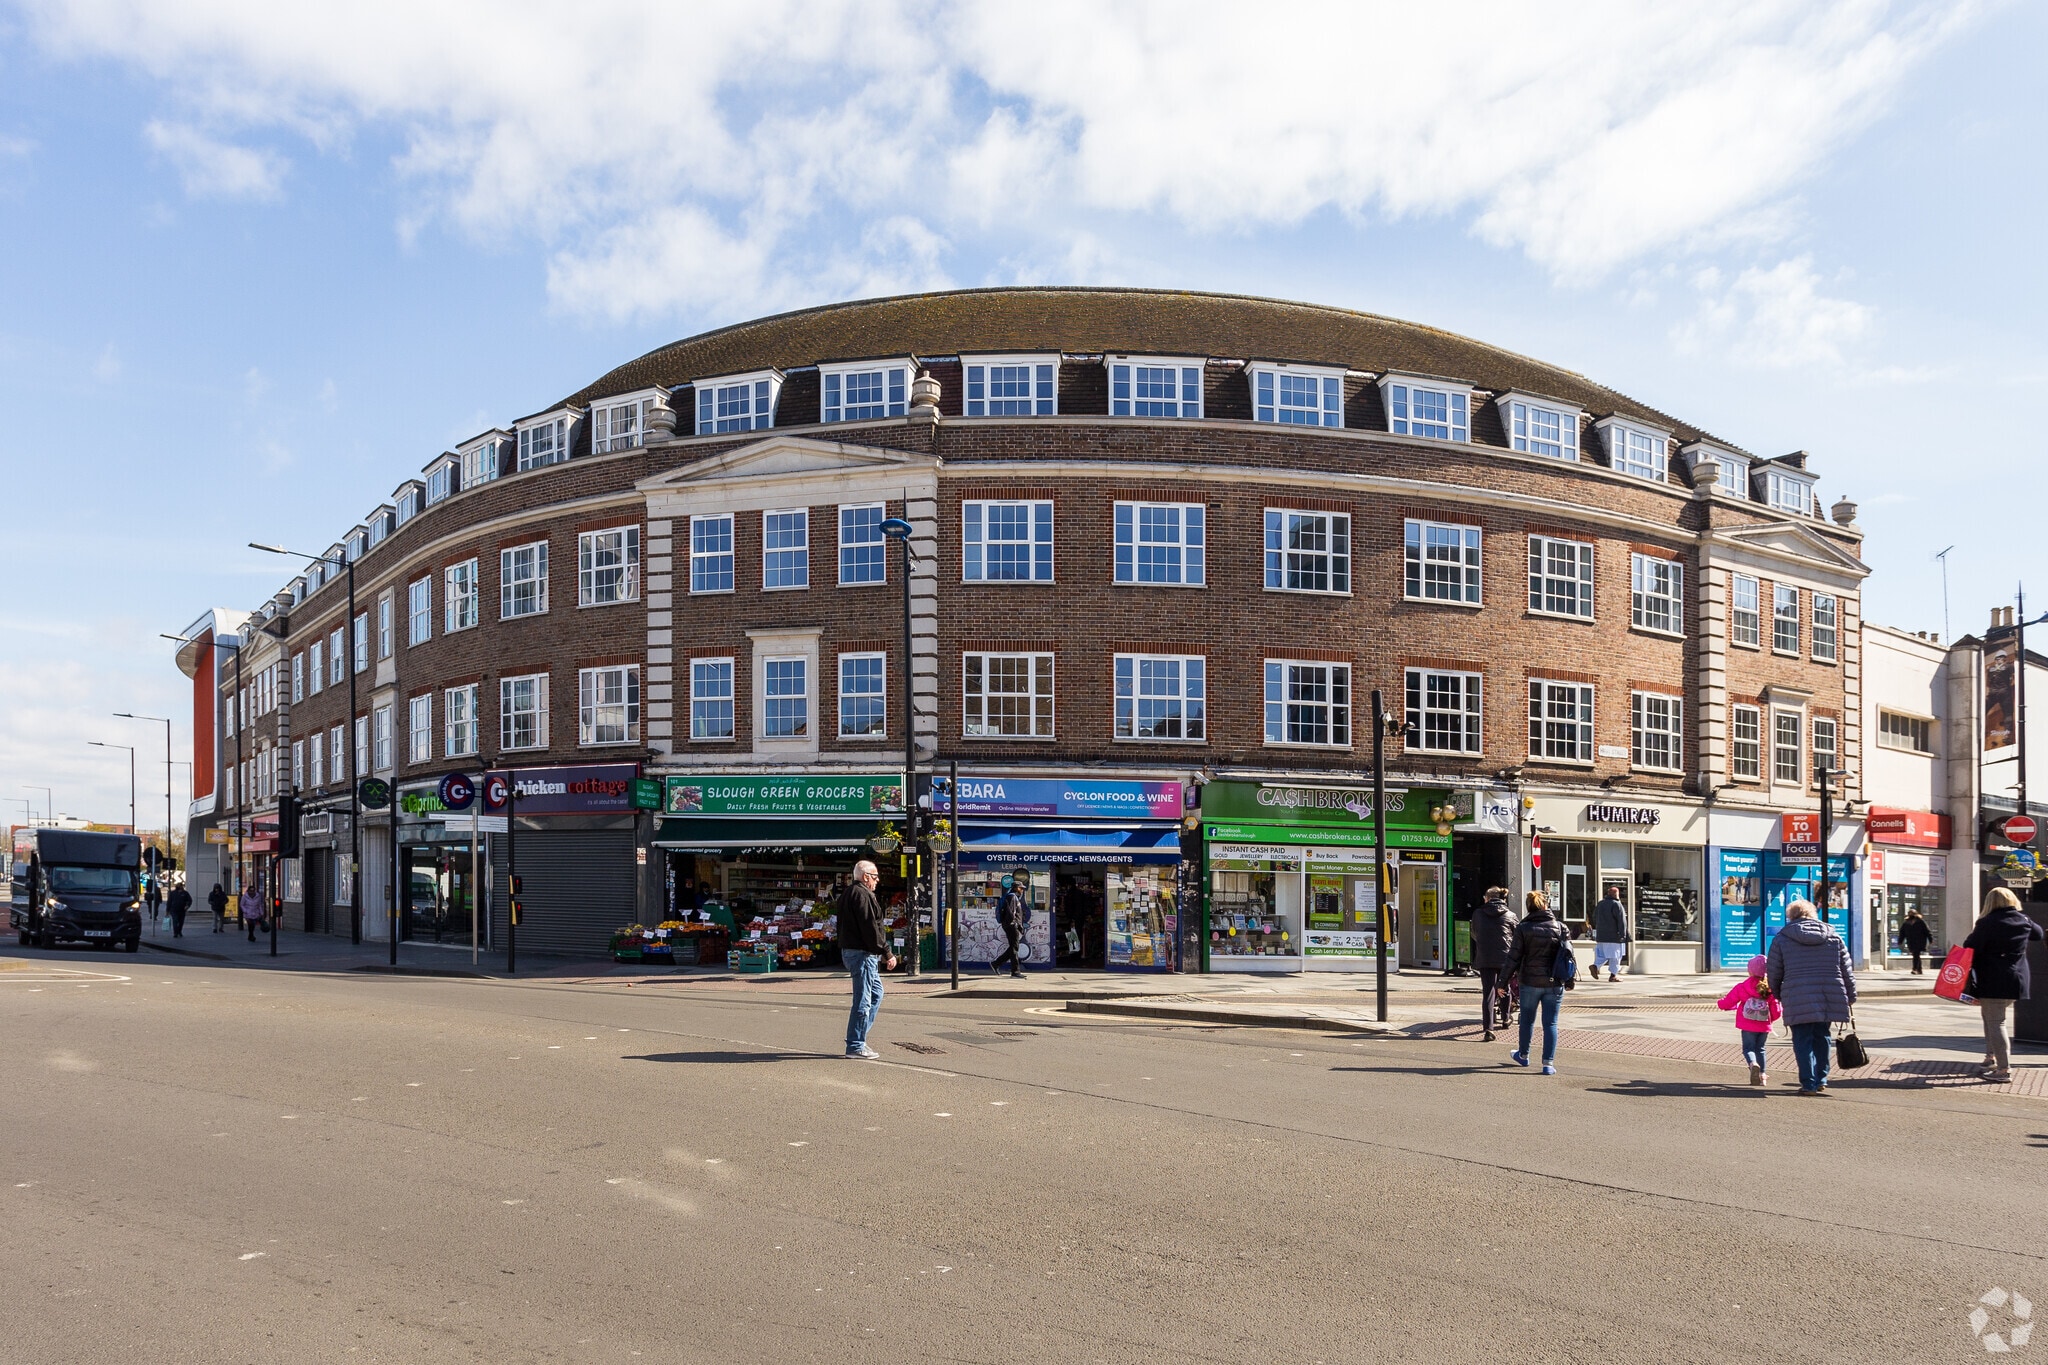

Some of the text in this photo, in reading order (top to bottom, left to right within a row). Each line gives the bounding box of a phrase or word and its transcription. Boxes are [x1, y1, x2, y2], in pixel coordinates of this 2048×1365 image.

[515, 780, 567, 794] hicken
[568, 779, 627, 797] cottage
[707, 786, 865, 798] SLOUGH GREEN GROCERS
[1064, 792, 1174, 803] CYCLON FOOD & WINE
[1587, 804, 1660, 826] HUMIRA'S
[1792, 822, 1809, 831] TO
[1871, 820, 1904, 828] Connells
[1289, 831, 1372, 841] www.cashbrokers.co.uk
[1401, 834, 1448, 844] 01753 941095
[1789, 832, 1812, 842] LET
[1786, 844, 1817, 853] focus
[1080, 855, 1133, 863] NEWSAGENTS
[1723, 854, 1758, 864] Protect yourself
[1737, 865, 1756, 873] Covid-19
